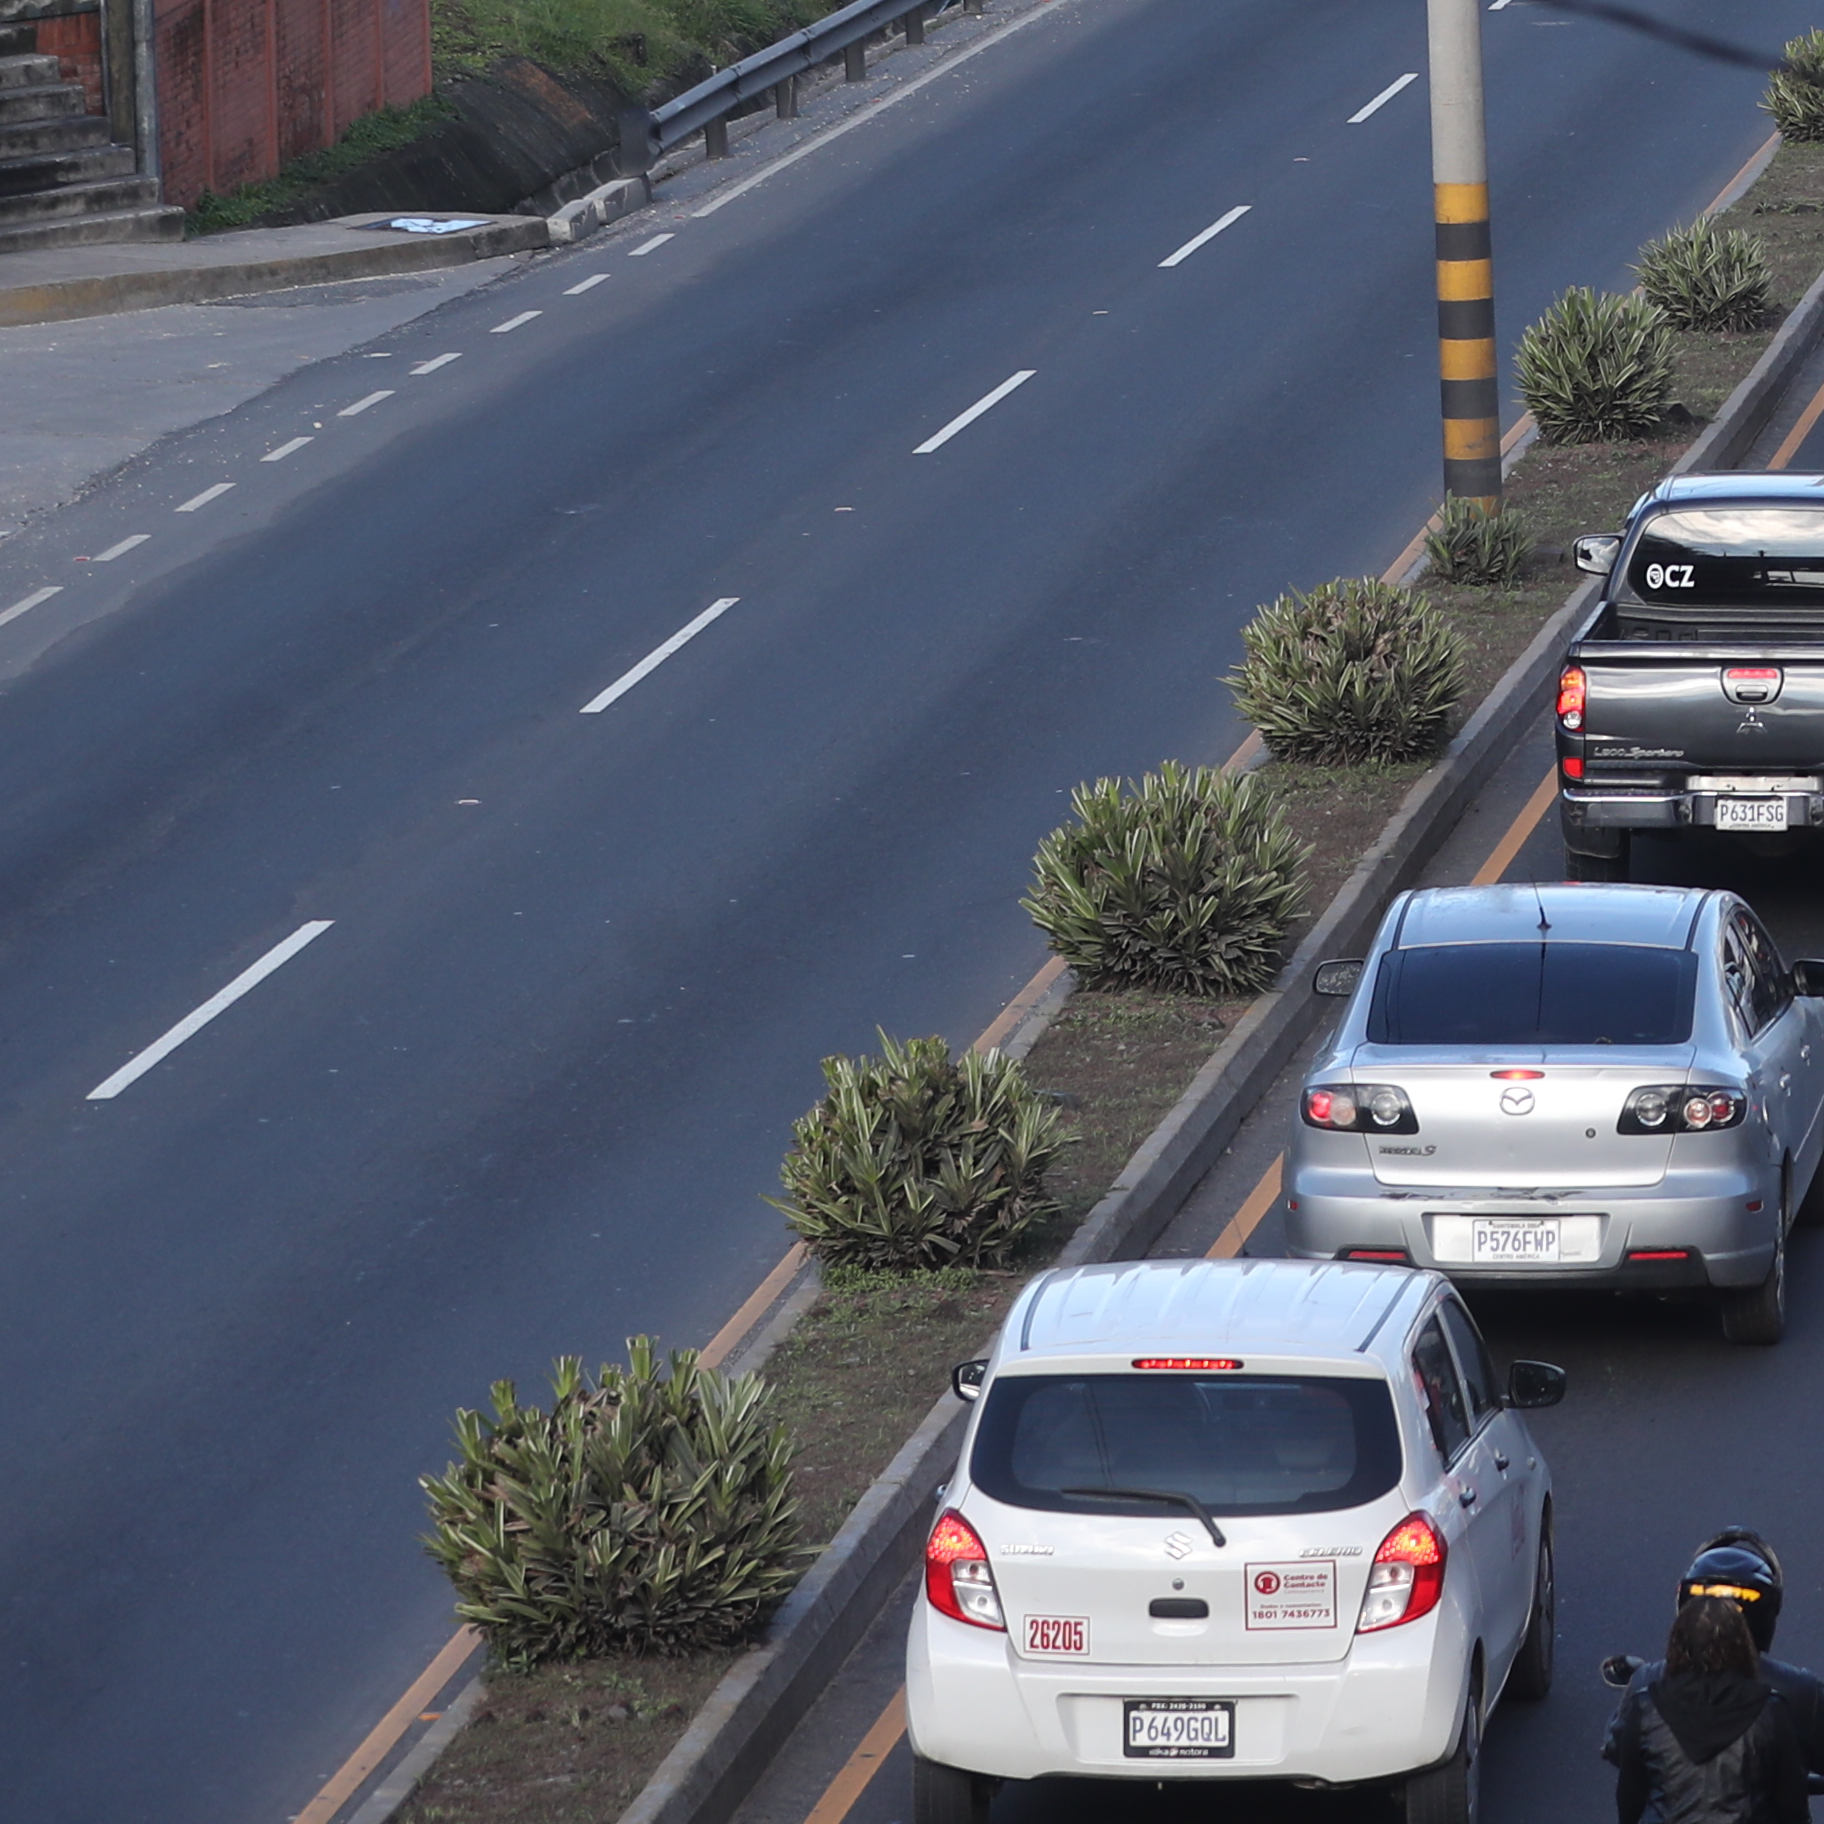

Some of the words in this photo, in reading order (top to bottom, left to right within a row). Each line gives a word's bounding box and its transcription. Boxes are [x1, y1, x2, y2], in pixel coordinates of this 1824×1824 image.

[1720, 803, 1784, 823] P631FSG
[1477, 1230, 1555, 1252] P576FWP
[1252, 1610, 1279, 1620] 1801
[1281, 1608, 1331, 1620] 7436773
[1030, 1619, 1084, 1651] 26205
[1131, 1715, 1228, 1743] P649GQL
